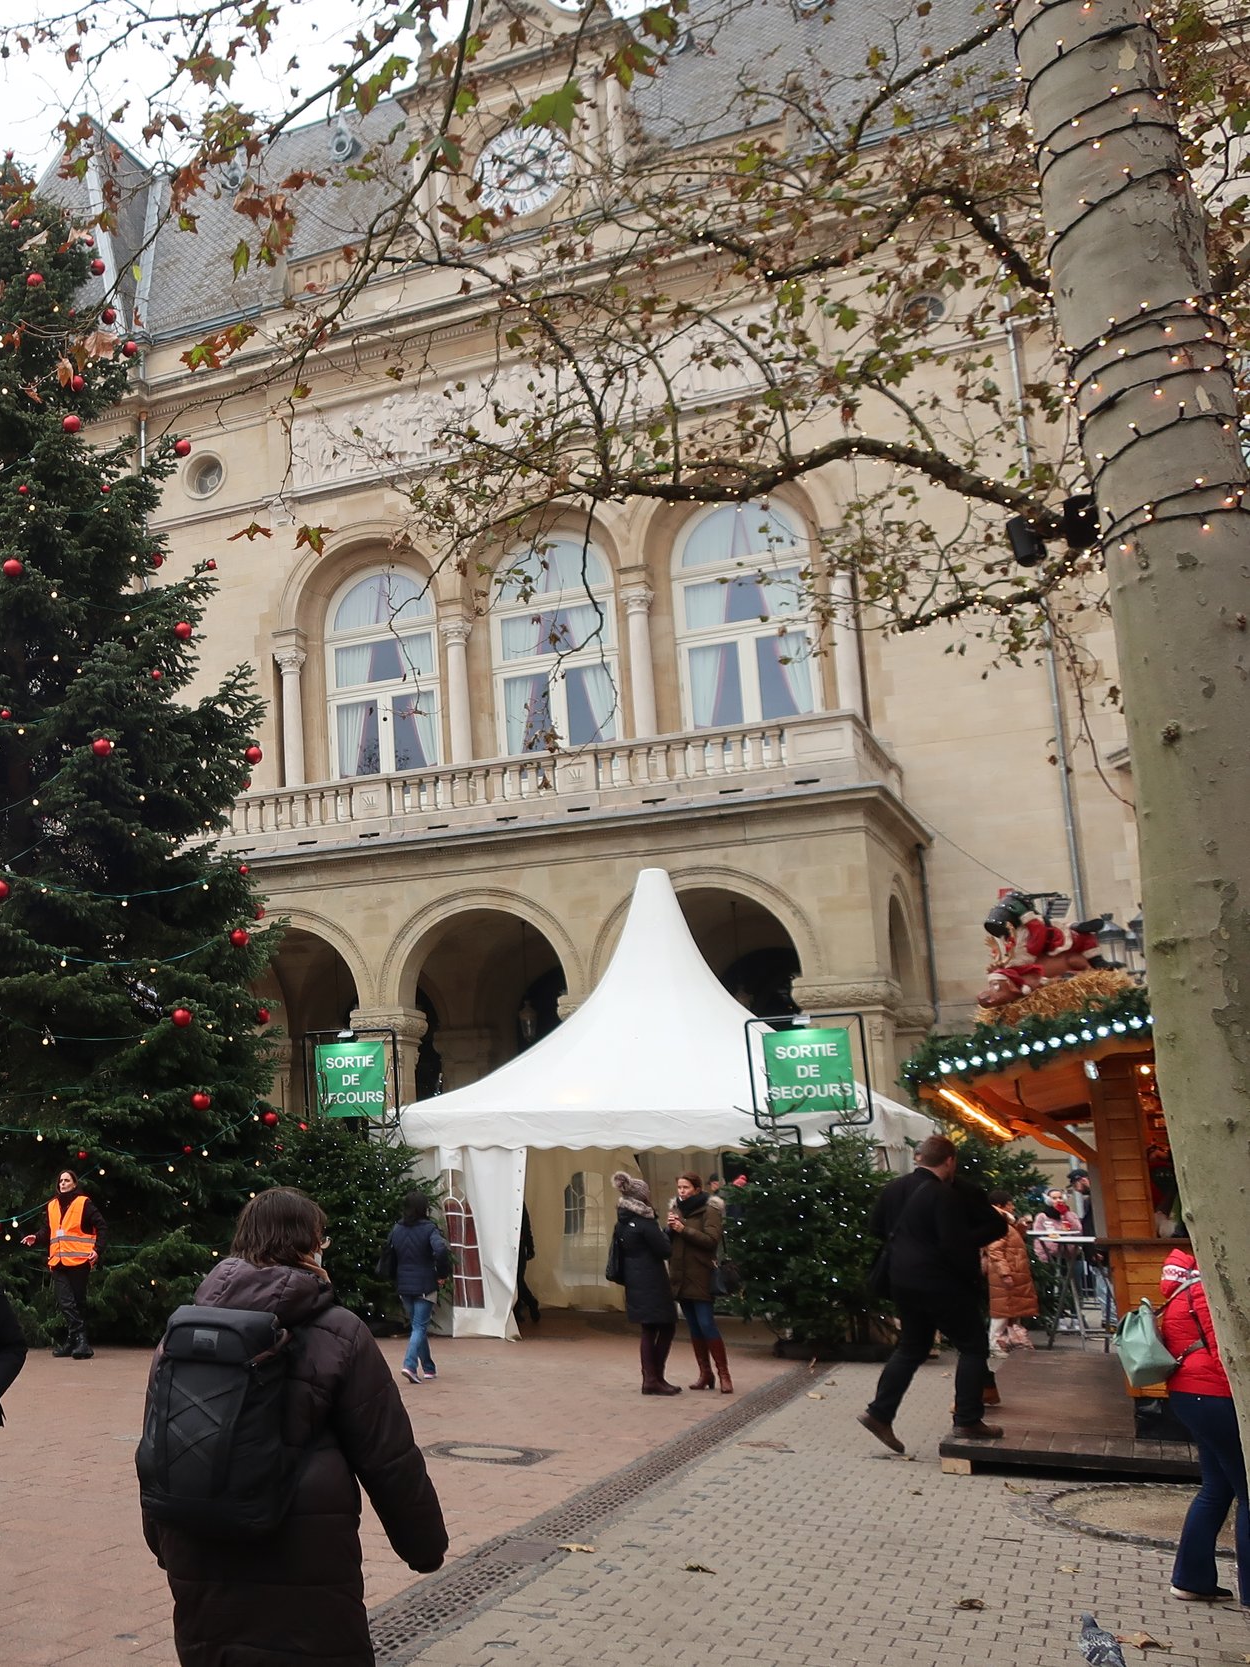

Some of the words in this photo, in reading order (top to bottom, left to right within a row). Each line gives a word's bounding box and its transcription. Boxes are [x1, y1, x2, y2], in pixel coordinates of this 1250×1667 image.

[775, 1043, 838, 1059] SORTIE
[326, 1055, 374, 1069] SORTIE
[796, 1065, 820, 1078] DE
[342, 1074, 360, 1086] DE
[770, 1083, 853, 1099] SECOURS
